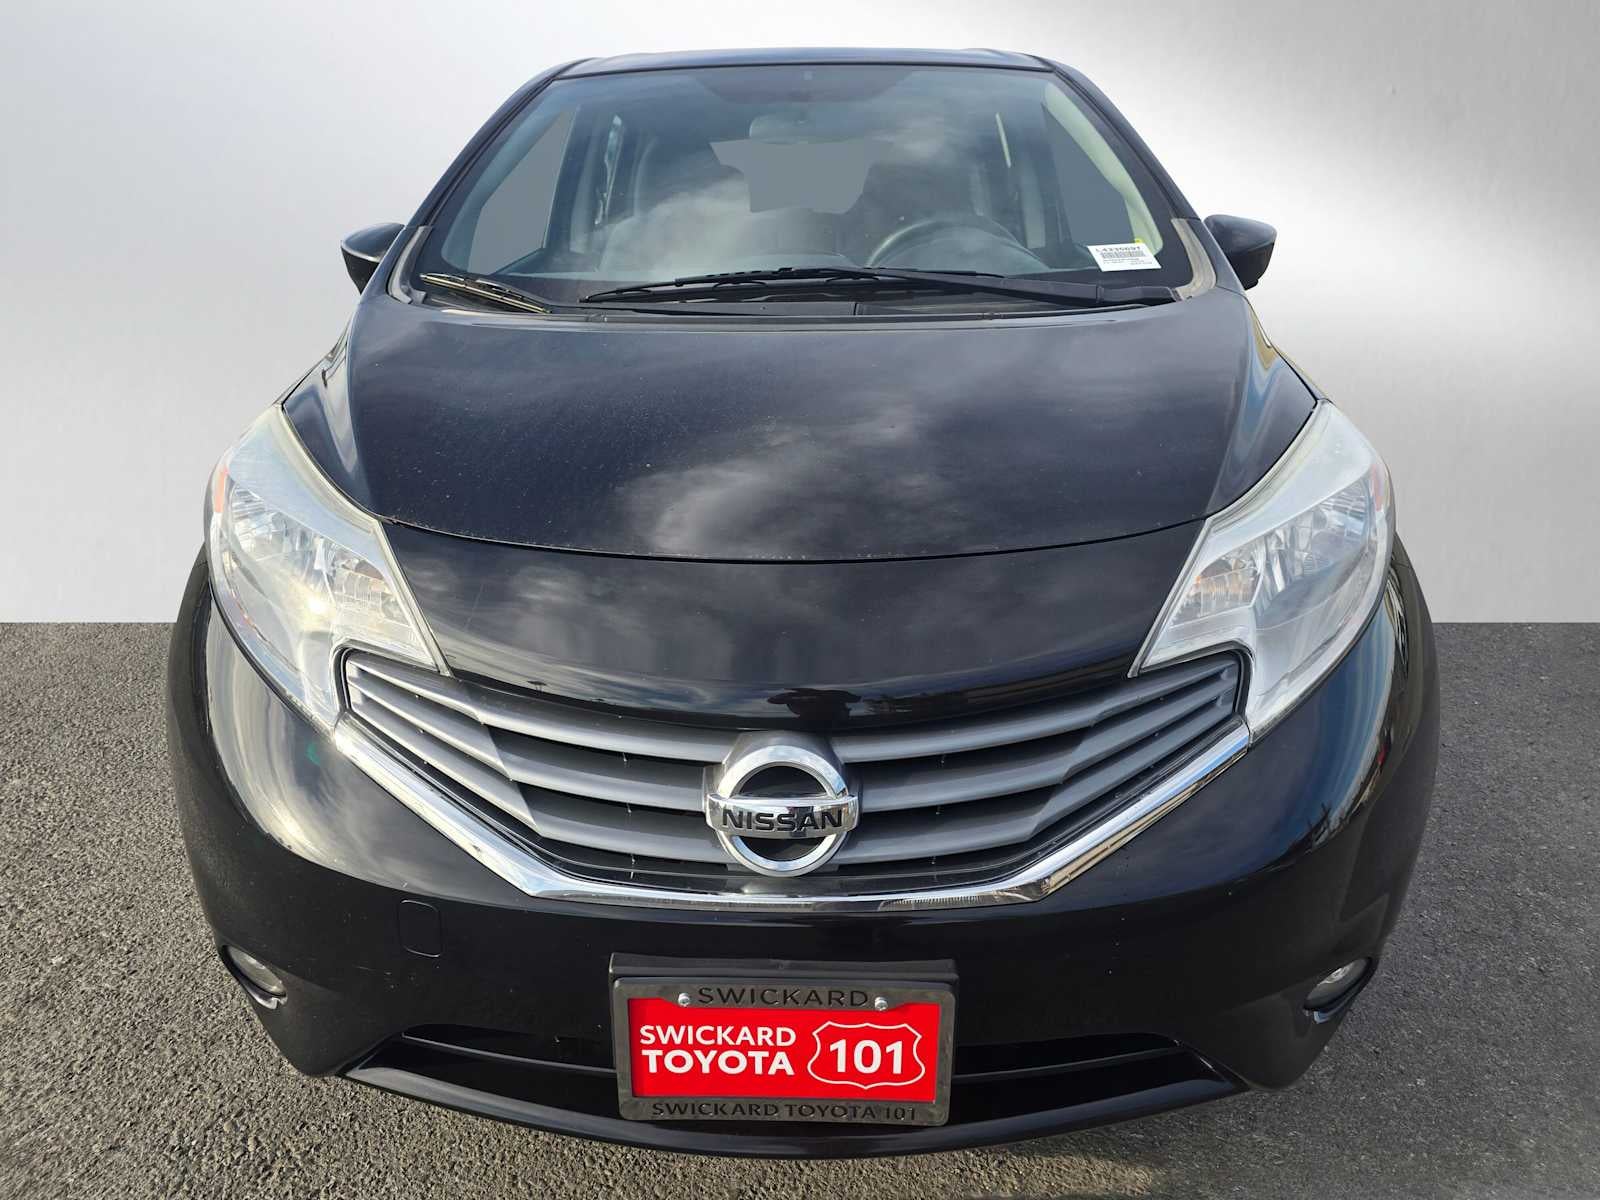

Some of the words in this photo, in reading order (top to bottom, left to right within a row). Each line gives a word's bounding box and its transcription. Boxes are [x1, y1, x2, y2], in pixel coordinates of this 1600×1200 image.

[722, 808, 842, 832] NISSAN
[699, 986, 869, 1007] SWICKARD
[639, 1024, 797, 1047] SWICKARD
[642, 1049, 795, 1076] TOYOTA
[829, 1039, 903, 1075] 101
[652, 1101, 779, 1118] SWICKARD
[785, 1103, 877, 1119] TOYOTA
[885, 1106, 917, 1121] 101
